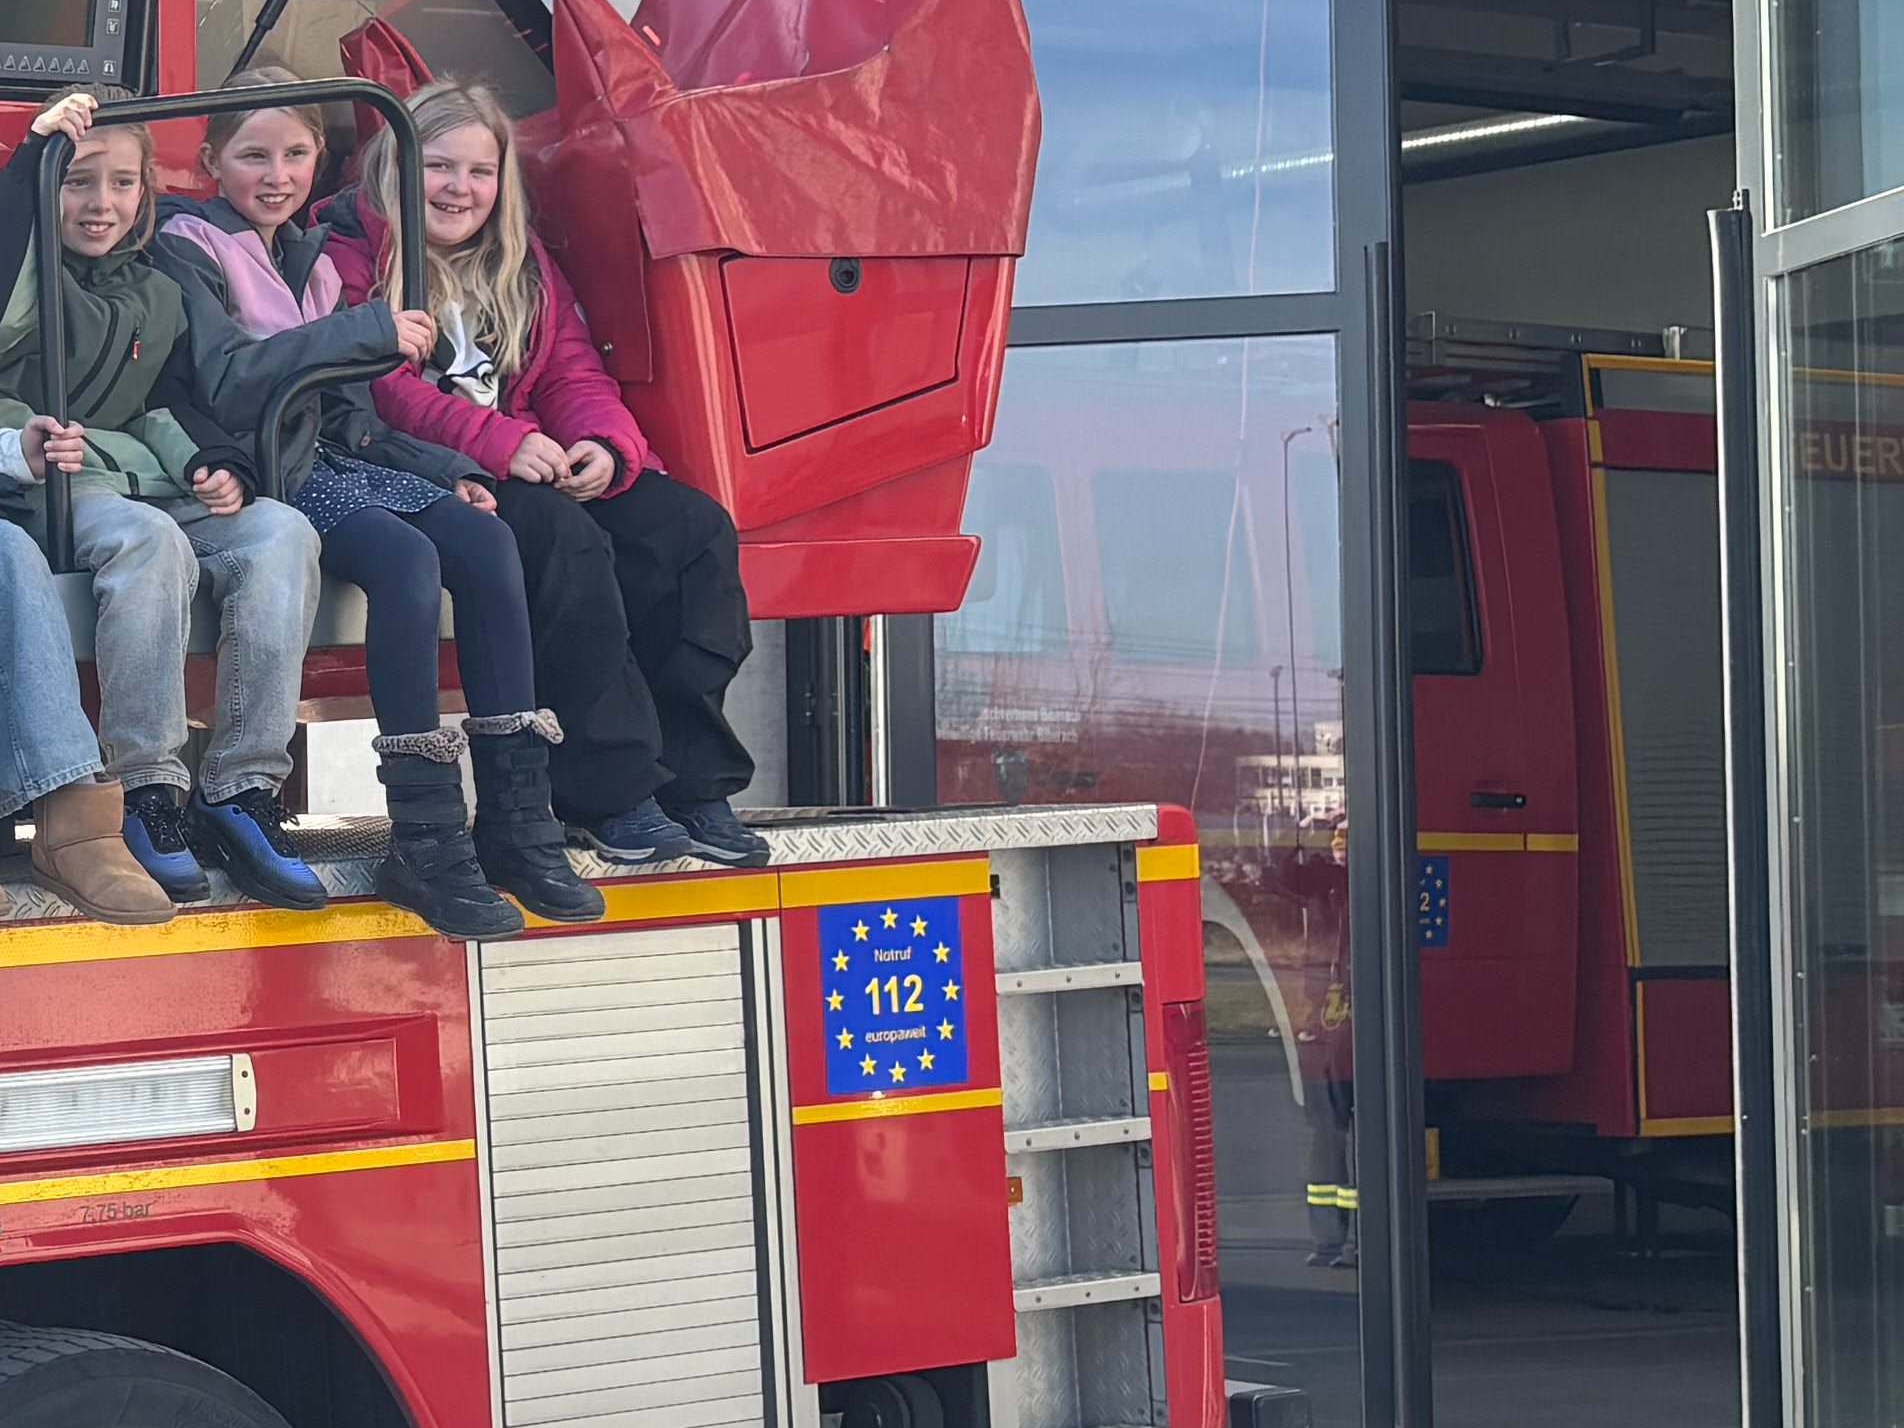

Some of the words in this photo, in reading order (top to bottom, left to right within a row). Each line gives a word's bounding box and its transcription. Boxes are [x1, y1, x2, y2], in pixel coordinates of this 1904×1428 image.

[1800, 432, 1904, 475] EUER
[873, 945, 912, 963] Notruf
[864, 973, 924, 1015] 112
[864, 1025, 927, 1045] europaweit
[123, 1200, 152, 1218] bar
